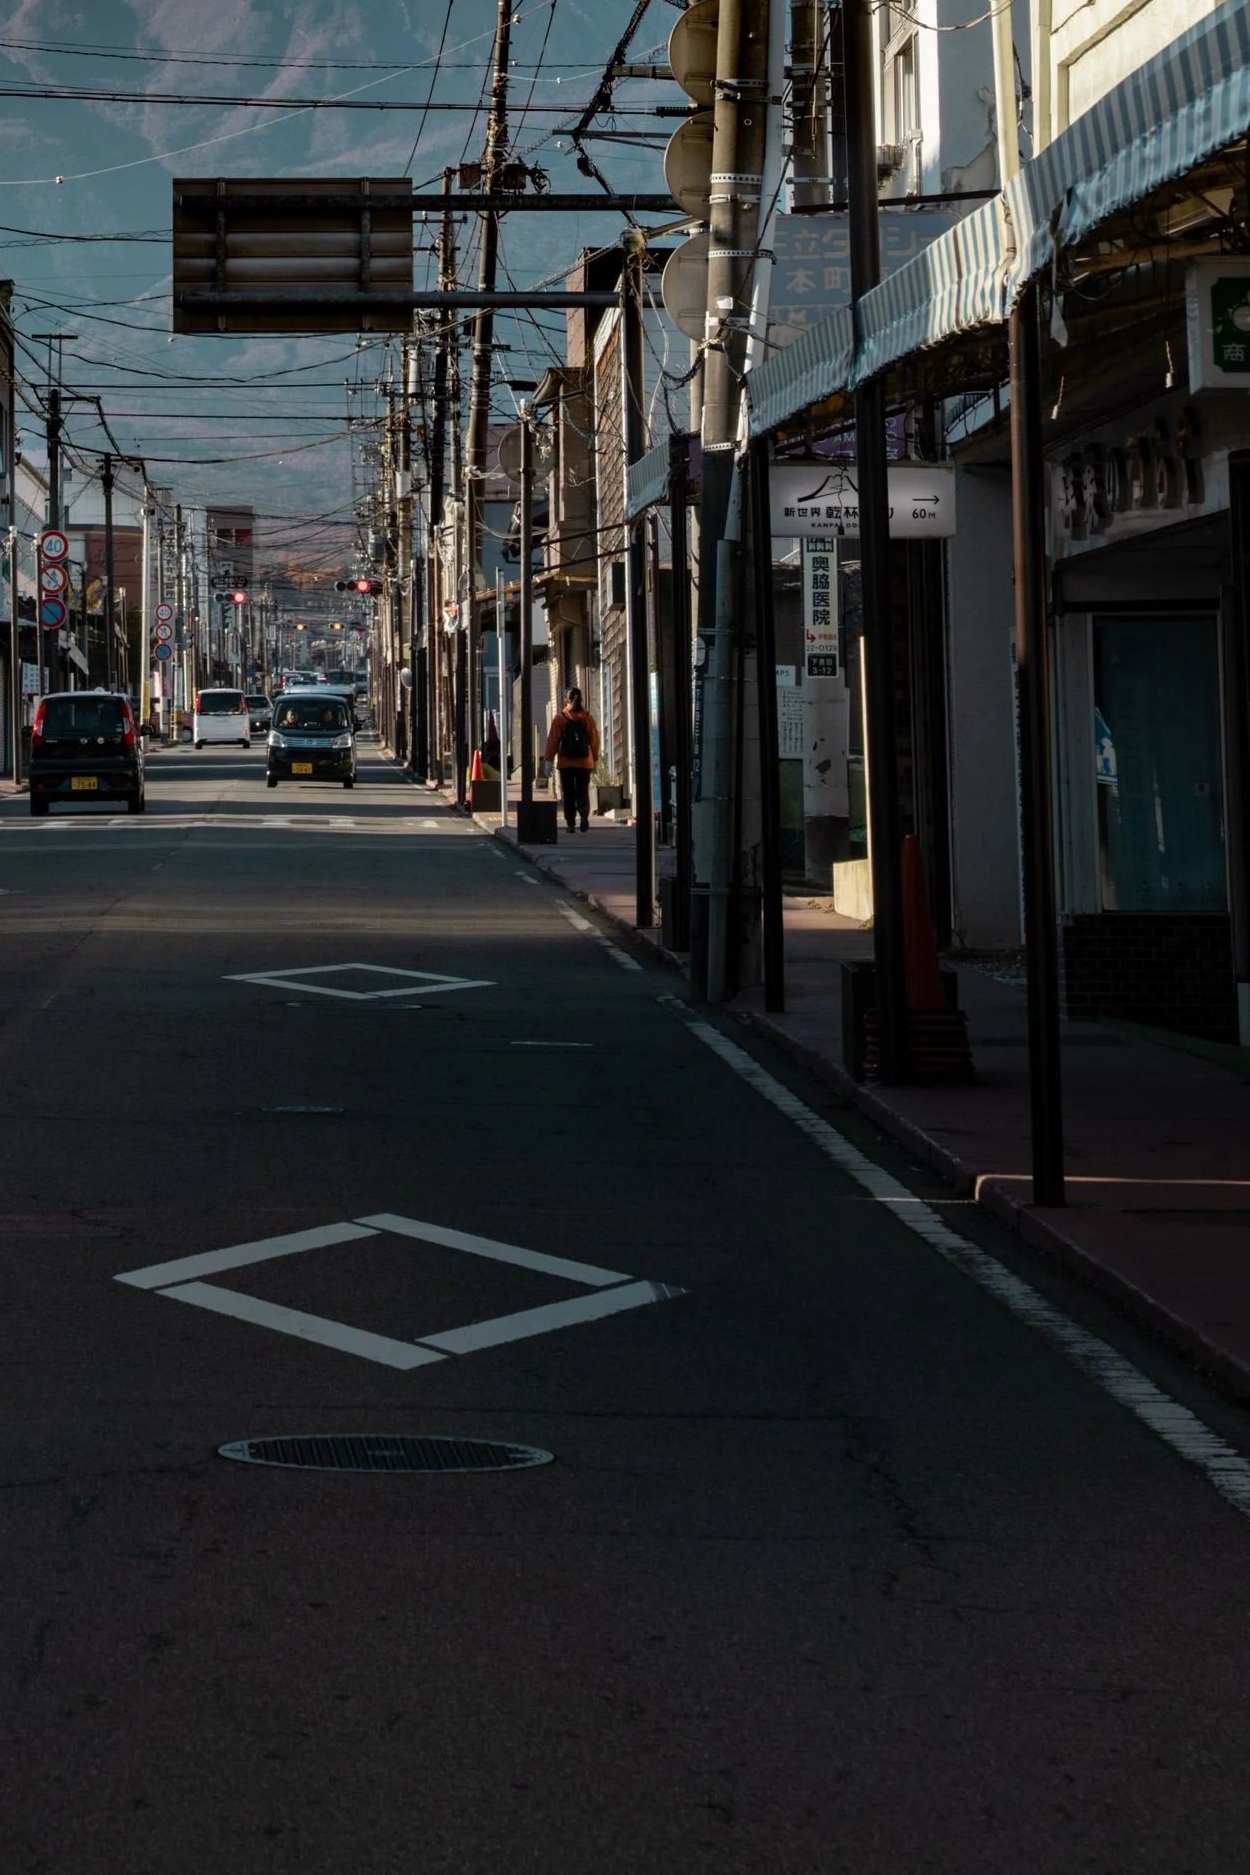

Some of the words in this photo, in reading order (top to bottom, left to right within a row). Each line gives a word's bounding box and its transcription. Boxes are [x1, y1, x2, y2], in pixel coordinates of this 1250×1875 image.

[784, 507, 821, 518] 新世界
[826, 506, 894, 519] 乾杯り
[46, 540, 62, 553] 40
[812, 556, 830, 626] 奥脇医院
